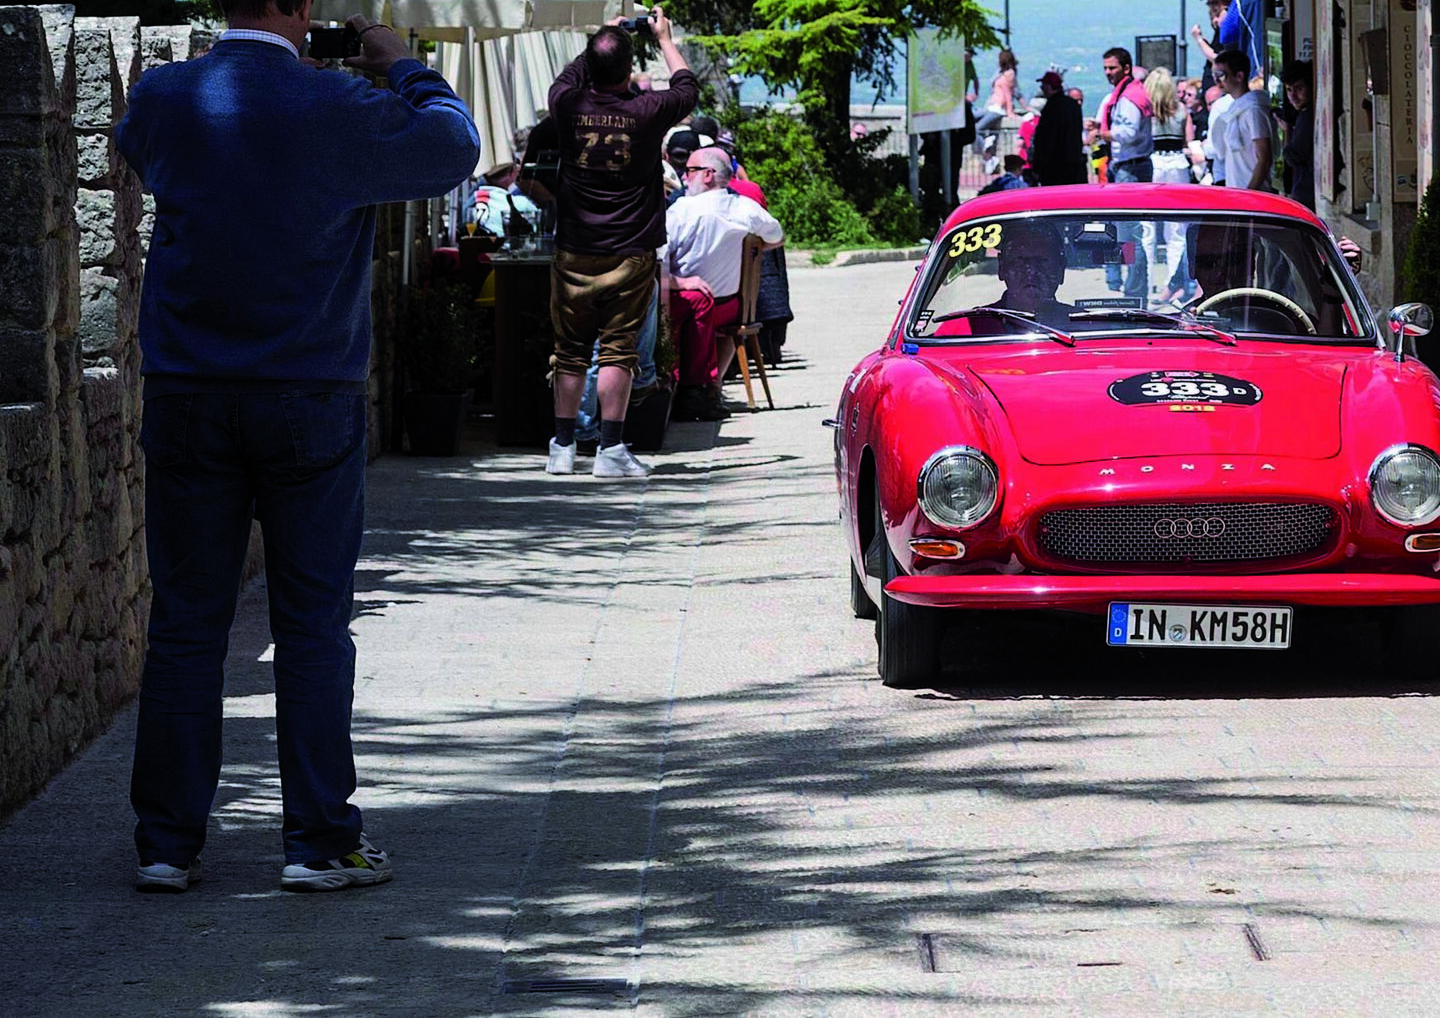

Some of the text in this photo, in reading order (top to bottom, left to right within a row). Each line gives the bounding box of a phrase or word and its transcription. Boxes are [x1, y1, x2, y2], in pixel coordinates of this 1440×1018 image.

[1403, 25, 1413, 144] CIOCCOLATERIA
[572, 114, 636, 129] TIMBERLAND
[575, 132, 631, 171] 73
[949, 224, 1002, 258] 333
[1140, 382, 1230, 397] 333
[1232, 387, 1247, 395] D
[1100, 463, 1275, 475] MONZA
[1114, 628, 1122, 637] D
[1130, 609, 1167, 640] IN
